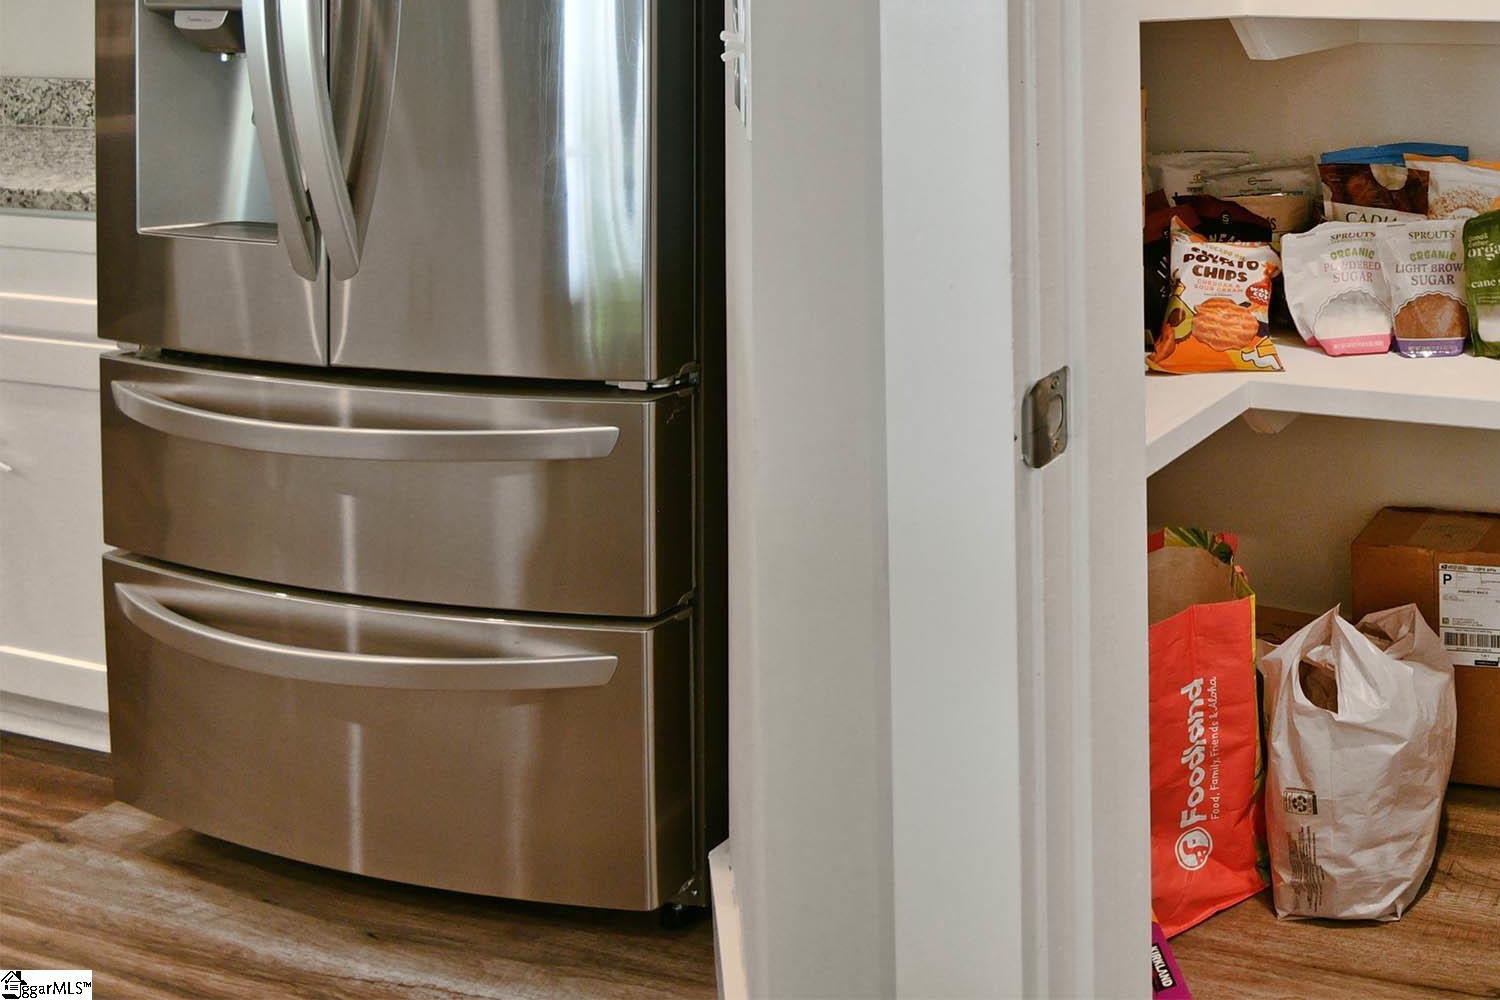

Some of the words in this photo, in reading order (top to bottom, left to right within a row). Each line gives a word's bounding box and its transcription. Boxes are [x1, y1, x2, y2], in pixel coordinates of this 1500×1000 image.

[1330, 231, 1376, 241] SPROUTS
[1408, 230, 1457, 240] SPROUTS
[1330, 247, 1375, 260] ORGANIC
[1410, 250, 1457, 262] ORGANIC
[1192, 264, 1248, 282] CHIPS
[1395, 263, 1427, 273] LIGHT
[1431, 263, 1465, 273] BROW
[1333, 272, 1373, 283] SUGAR
[1411, 274, 1455, 286] SUGAR
[1471, 279, 1496, 288] cane
[1443, 573, 1452, 584] P
[1180, 677, 1207, 829] Foodland
[1152, 945, 1173, 987] KIRKLAND
